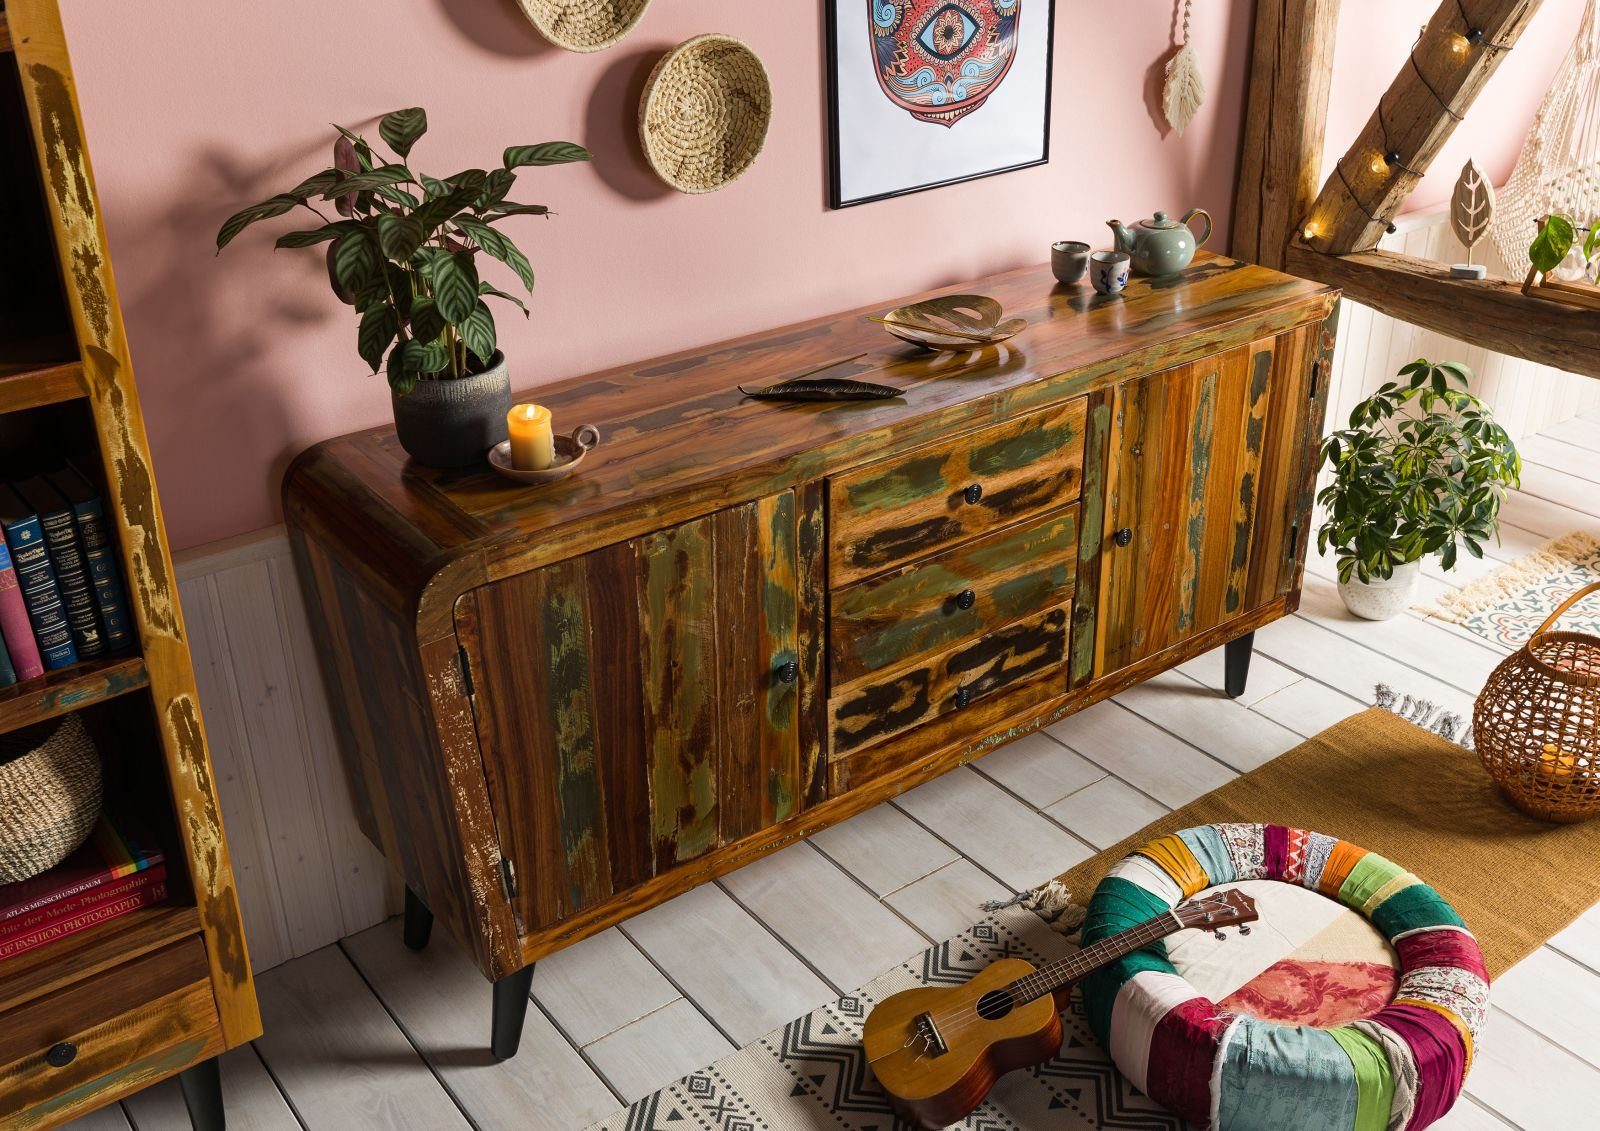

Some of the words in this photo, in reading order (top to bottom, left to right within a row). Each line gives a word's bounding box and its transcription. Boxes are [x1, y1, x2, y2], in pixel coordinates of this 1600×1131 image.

[6, 905, 30, 919] ATLAS
[30, 893, 62, 910] MENSCH
[61, 887, 79, 900] UND
[79, 879, 101, 892] RAUM
[0, 943, 14, 956] OF
[15, 925, 62, 951] FASHION
[63, 895, 142, 932] PHOTOGRAPHY
[24, 915, 43, 928] der
